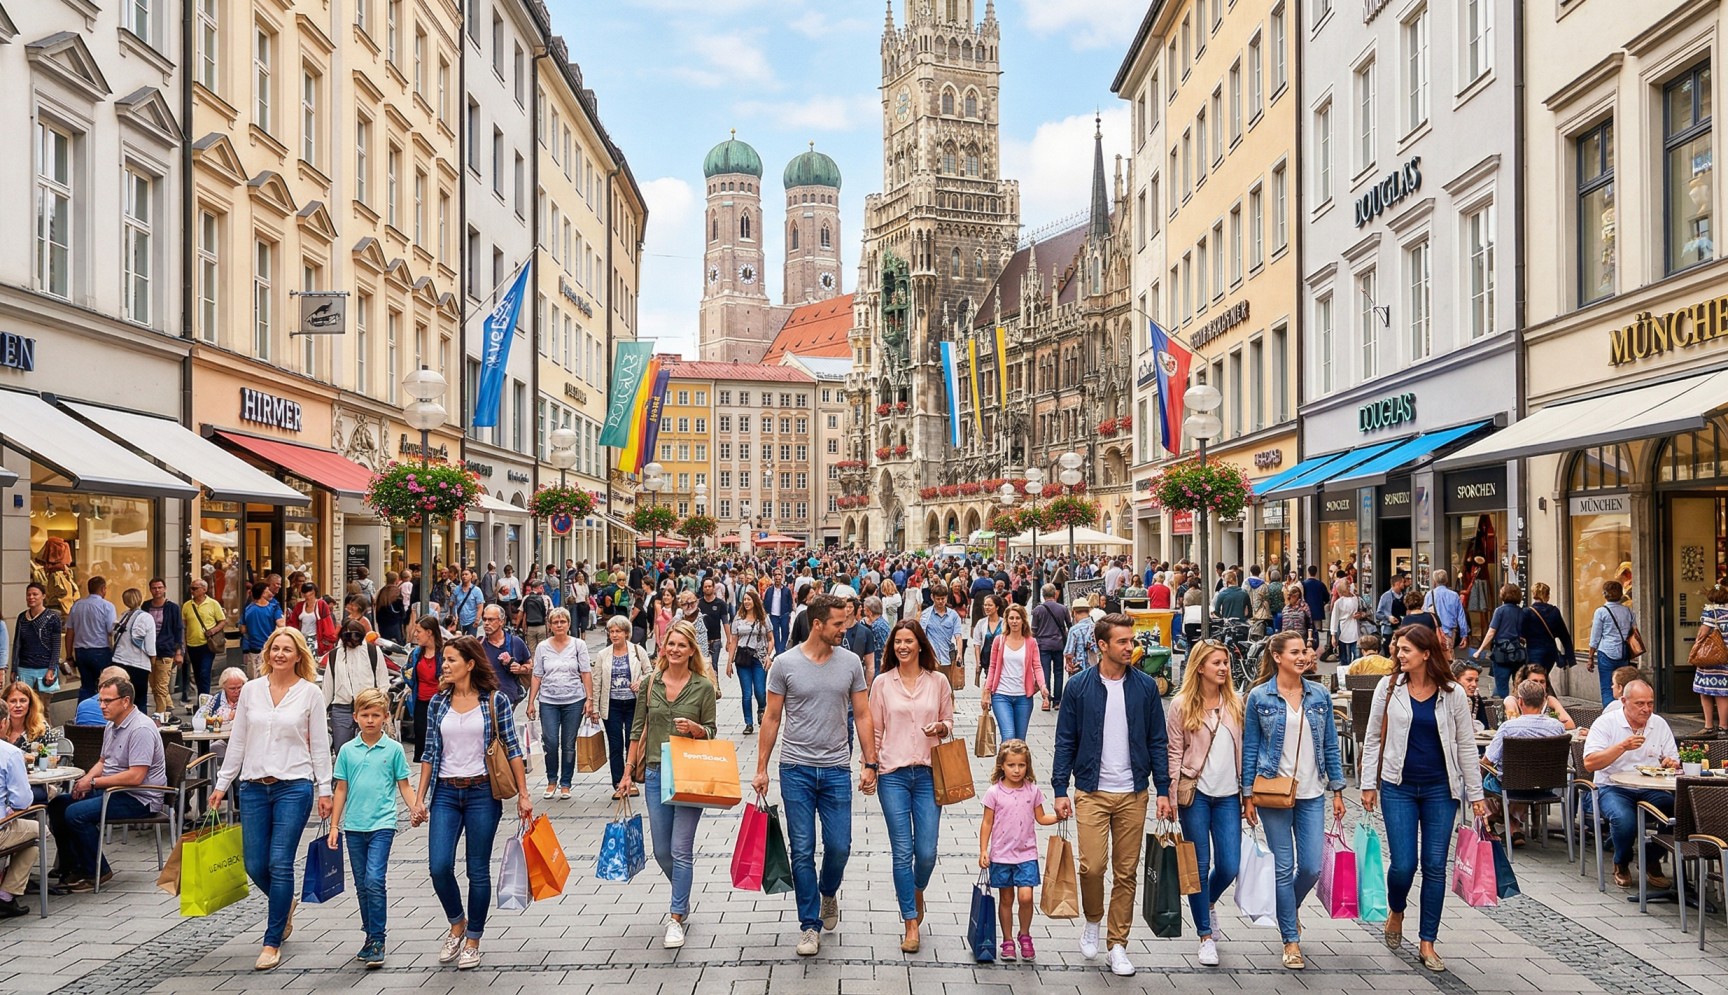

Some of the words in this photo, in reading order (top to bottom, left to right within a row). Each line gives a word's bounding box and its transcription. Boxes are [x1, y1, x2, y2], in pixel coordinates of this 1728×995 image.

[1355, 155, 1422, 228] DOUGLAS
[1607, 294, 1728, 367] MÜNCHE
[241, 387, 302, 432] HIRMER
[1357, 391, 1417, 432] DOUGLAS
[1457, 482, 1496, 499] SPORCHEN
[1580, 498, 1622, 512] MÜNCHEN
